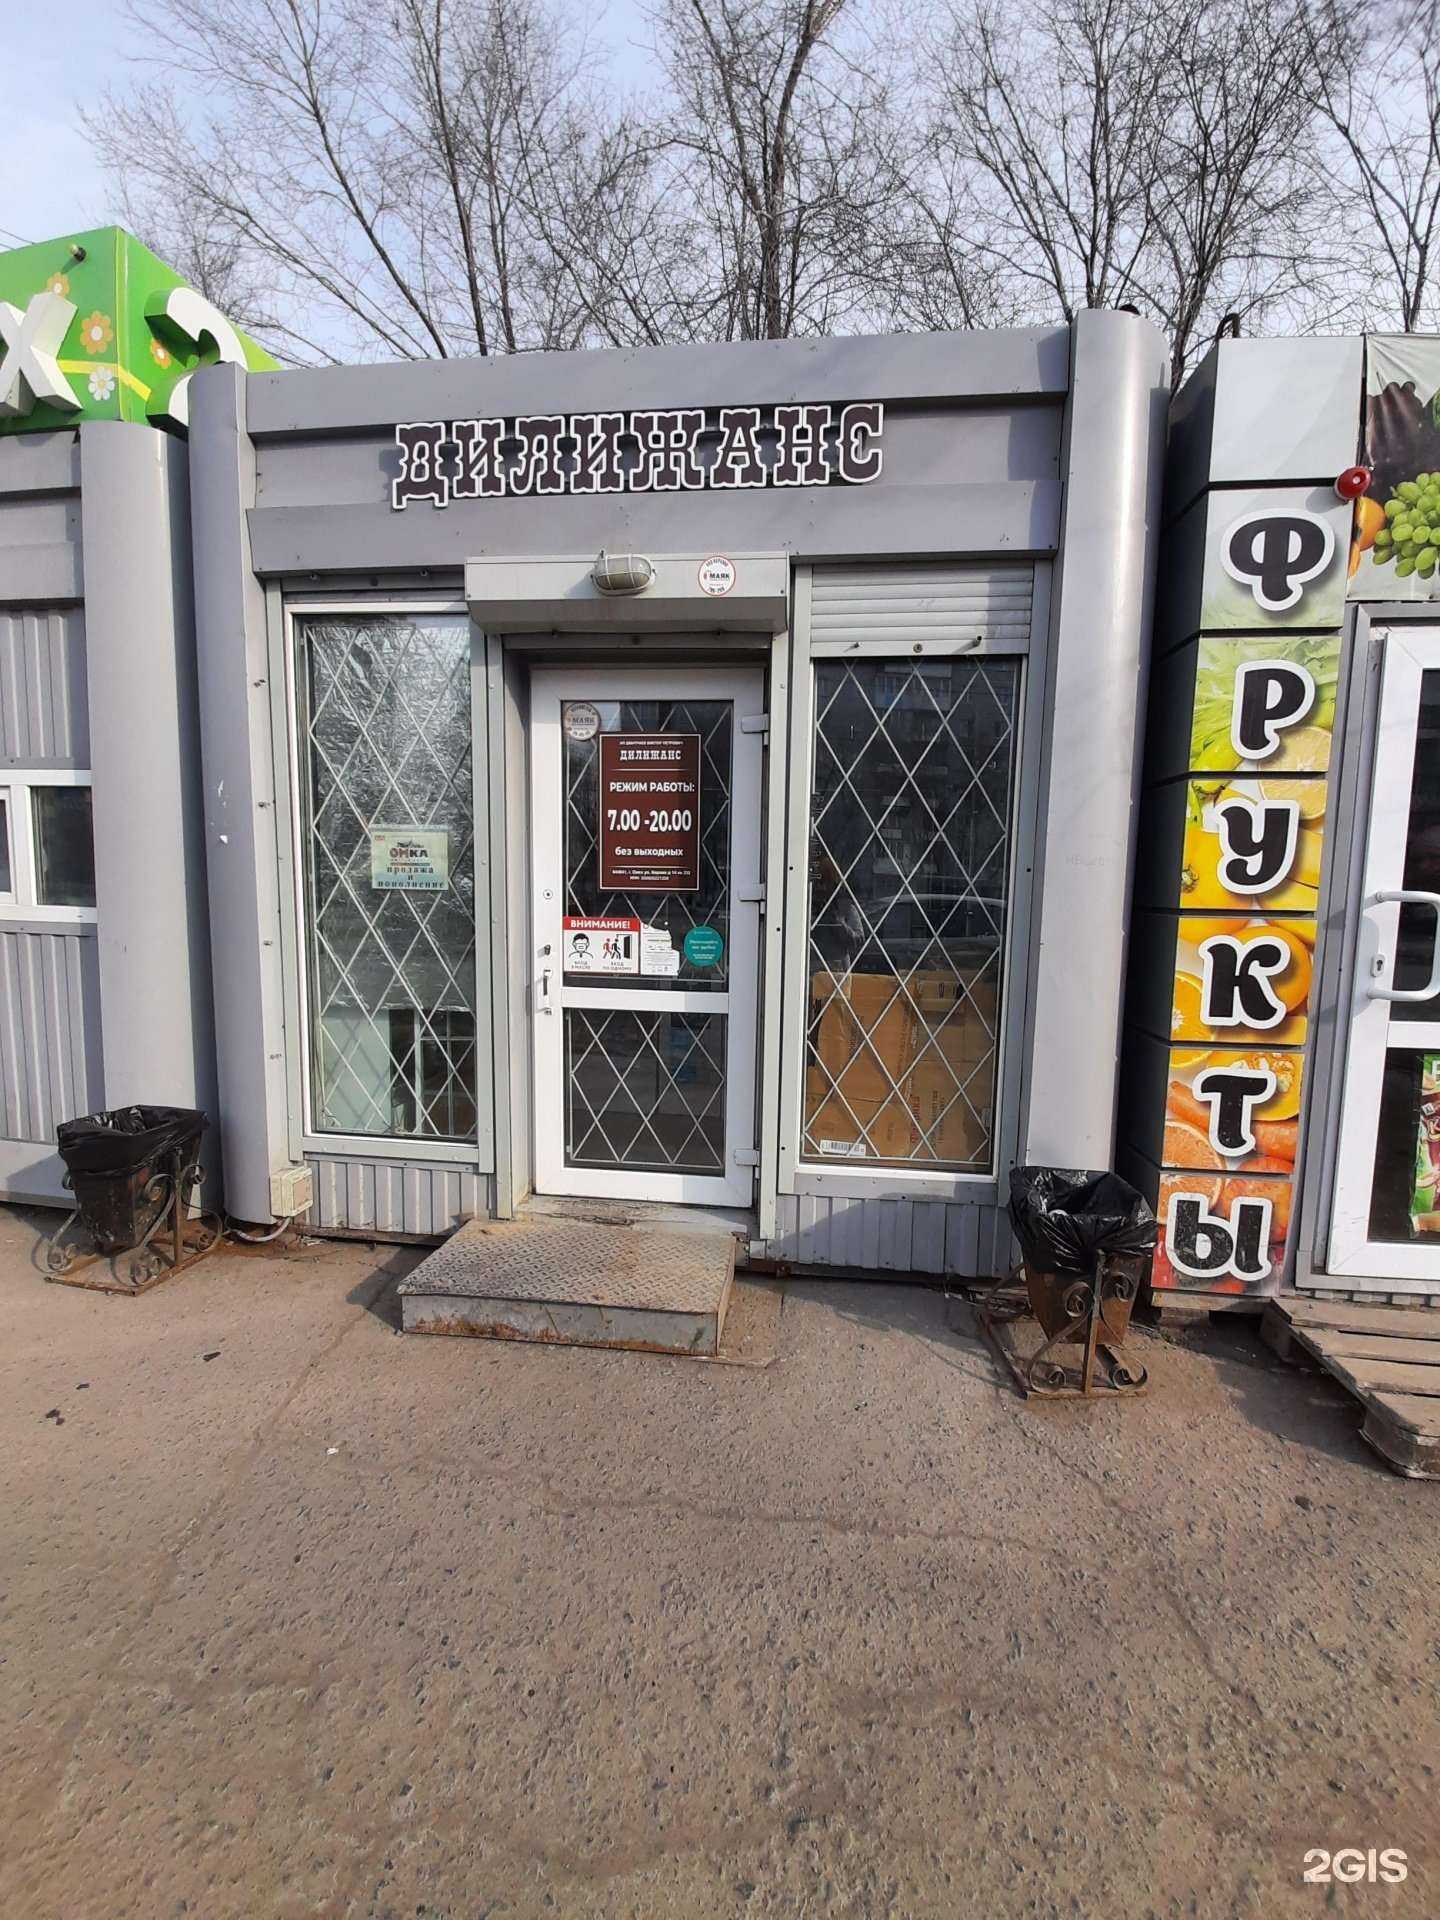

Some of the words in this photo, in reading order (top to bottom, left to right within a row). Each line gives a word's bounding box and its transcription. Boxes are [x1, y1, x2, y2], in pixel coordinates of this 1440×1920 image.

[391, 402, 884, 510] ДИЛИЖАНС
[619, 749, 682, 761] ДИЛИЖАНС
[609, 782, 648, 792] РЕЖИМ
[650, 782, 695, 793] РАБОТЫ:
[607, 809, 641, 831] 7.00
[389, 847, 428, 858] ОМКА
[615, 846, 632, 856] без
[633, 847, 684, 857] выходных
[1163, 506, 1337, 1283] ФРУКТЫ
[570, 919, 630, 929] ВНИМАНИЕ!
